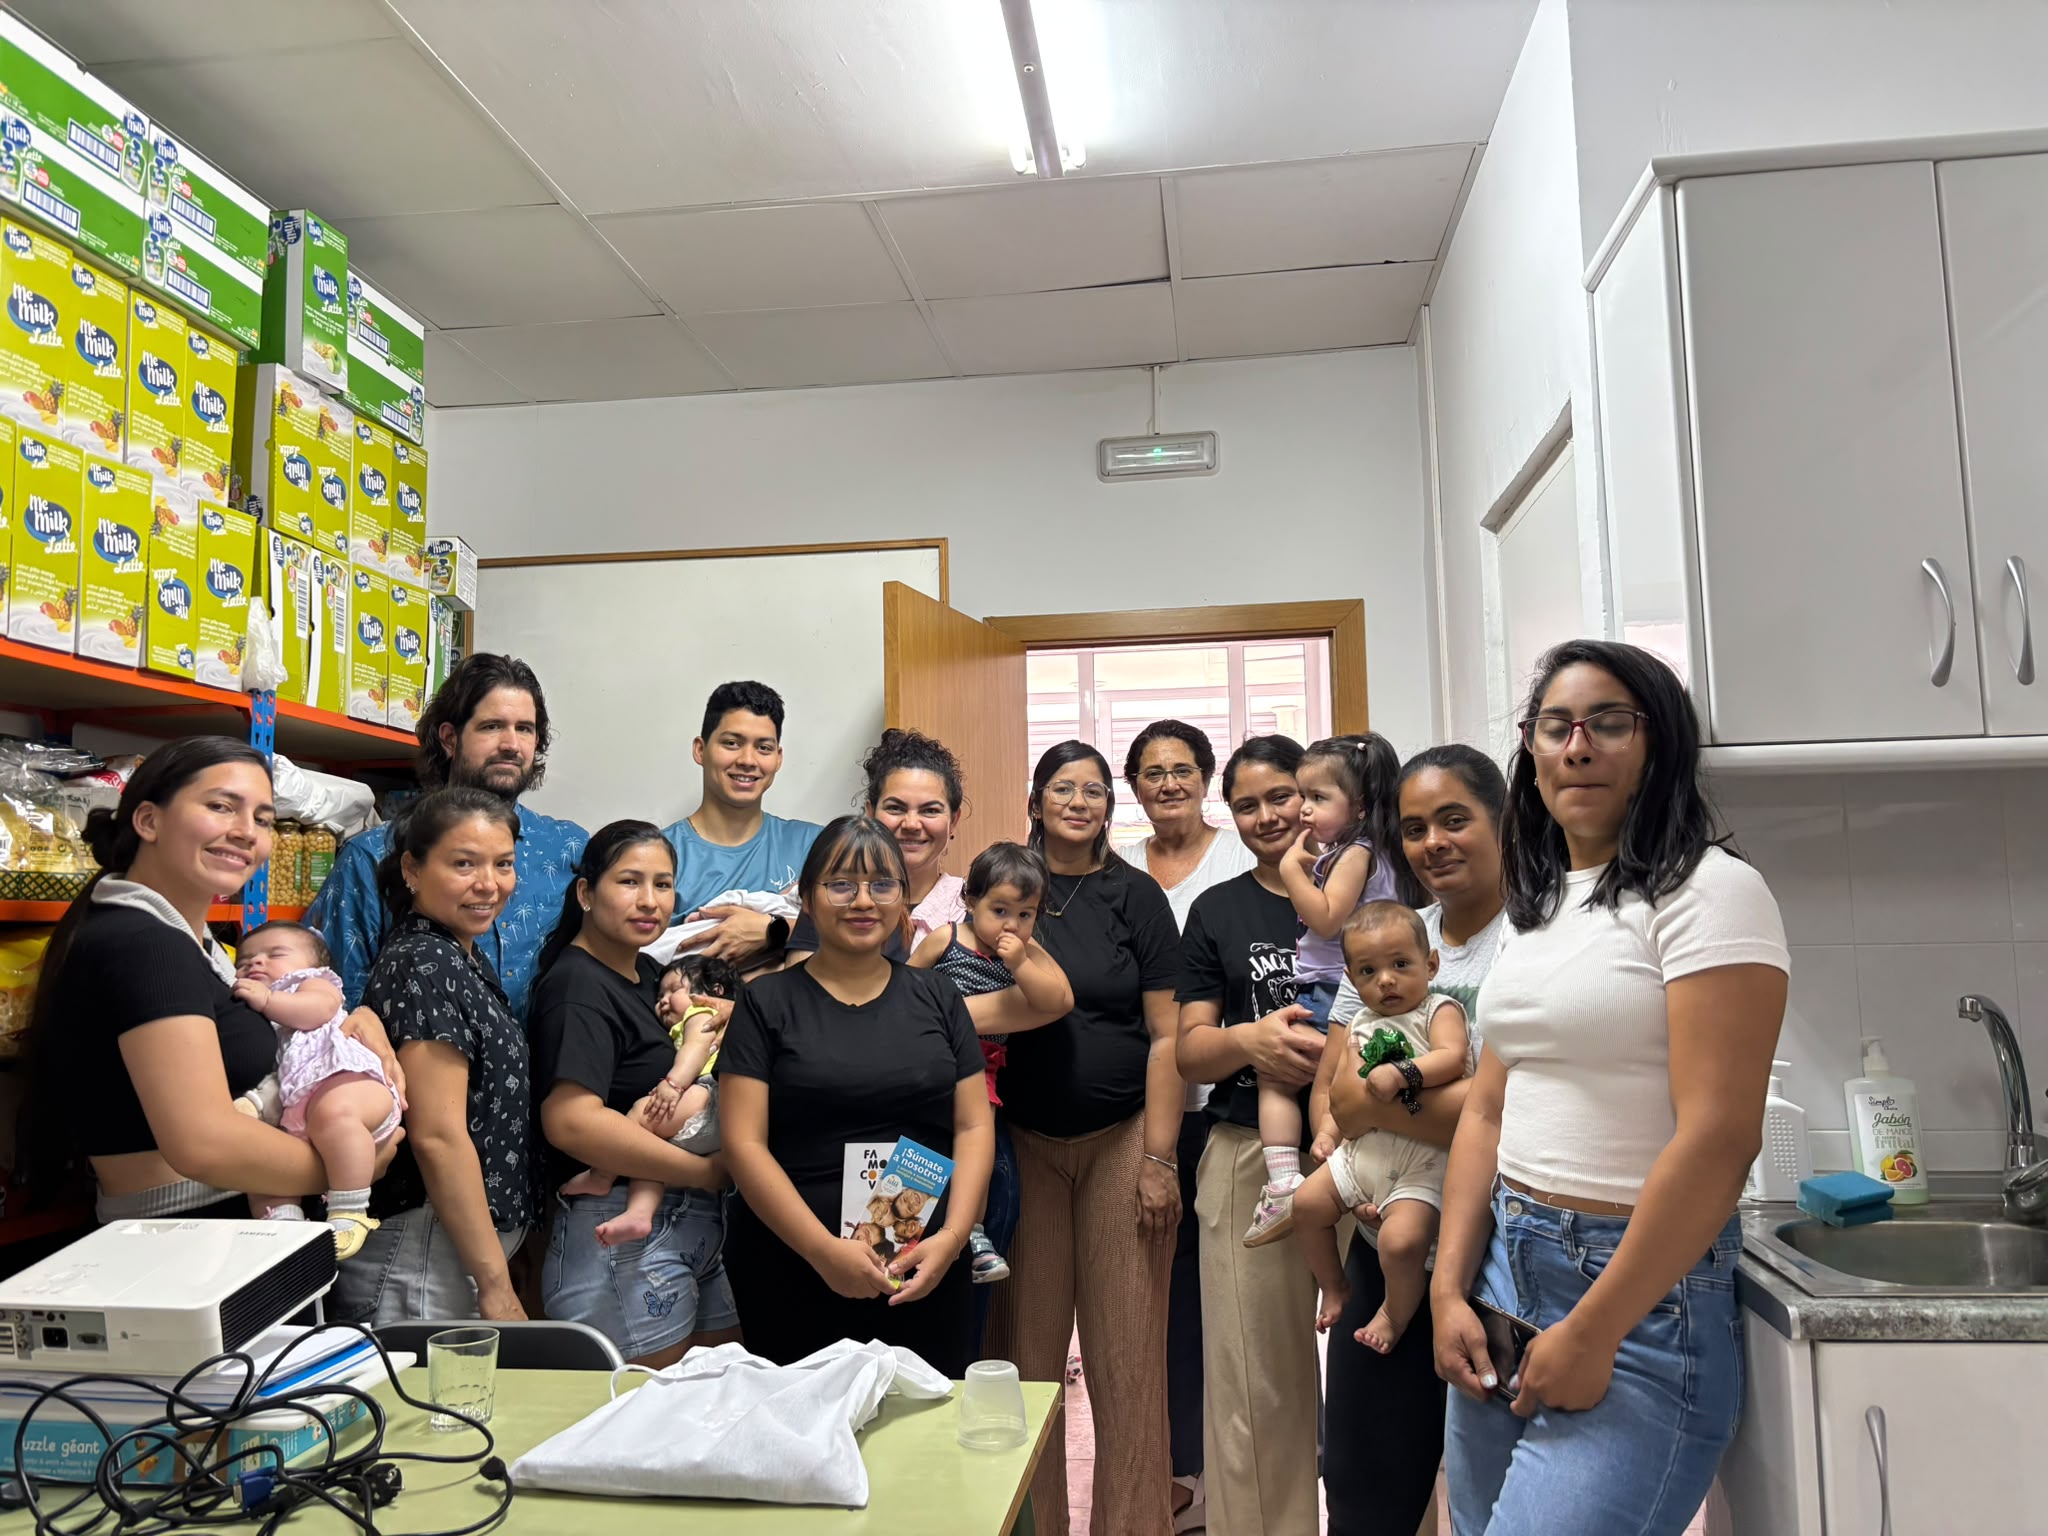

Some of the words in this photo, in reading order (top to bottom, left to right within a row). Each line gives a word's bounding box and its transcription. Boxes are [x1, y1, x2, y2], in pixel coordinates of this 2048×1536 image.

[1248, 953, 1290, 981] JACK
[1872, 1112, 1912, 1128] Jabón
[893, 1153, 900, 1162] a
[901, 1157, 948, 1184] nosotros!
[901, 1147, 944, 1173] ¡Súmate
[22, 1435, 56, 1452] uzzle
[61, 1439, 100, 1457] géant
